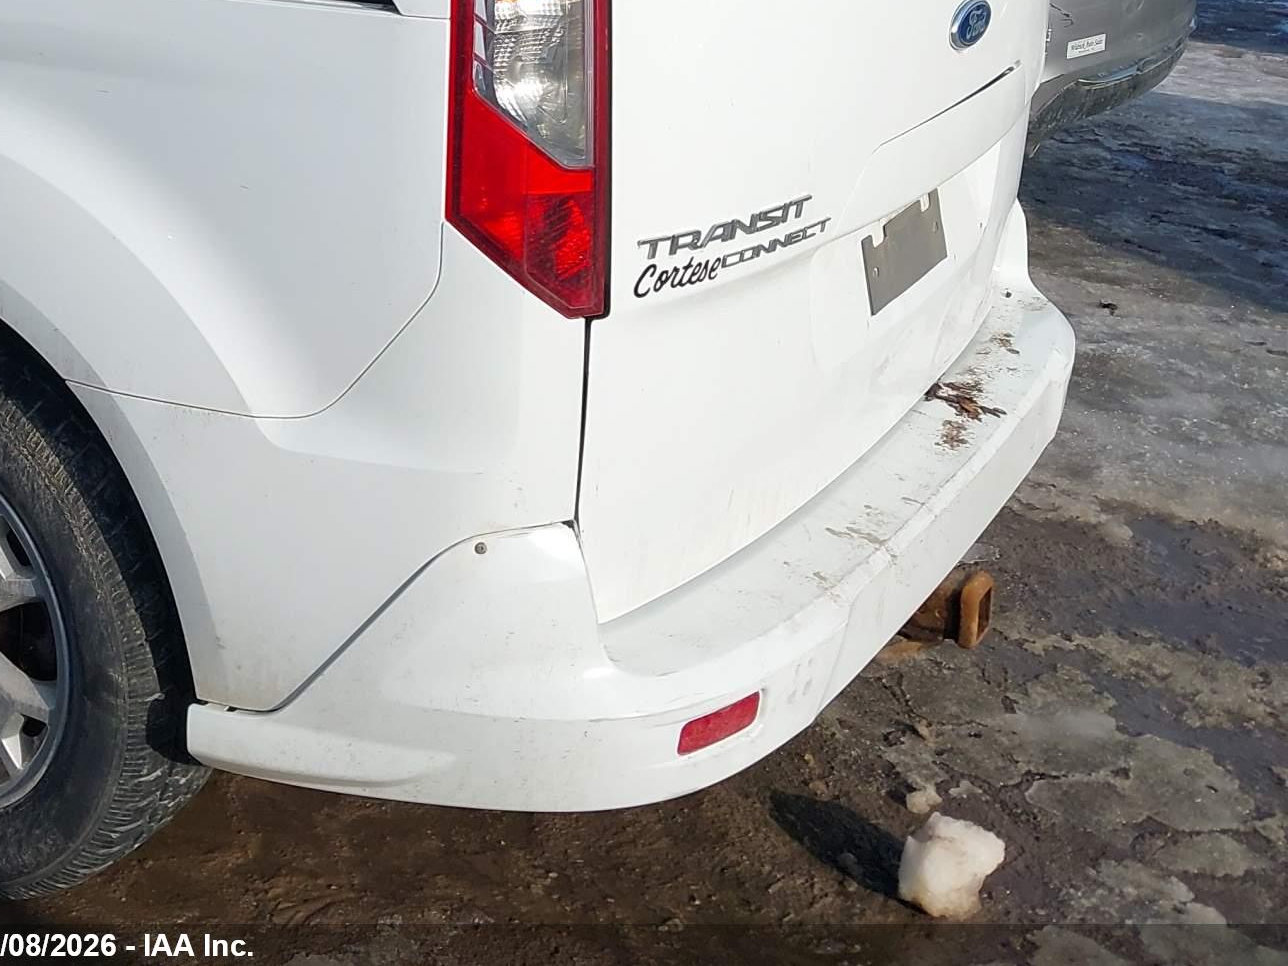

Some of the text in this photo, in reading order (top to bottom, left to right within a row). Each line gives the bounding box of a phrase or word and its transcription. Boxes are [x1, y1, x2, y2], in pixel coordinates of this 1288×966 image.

[637, 194, 813, 259] TRANSIT
[721, 217, 831, 268] CONNECT
[633, 256, 721, 298] Cortese
